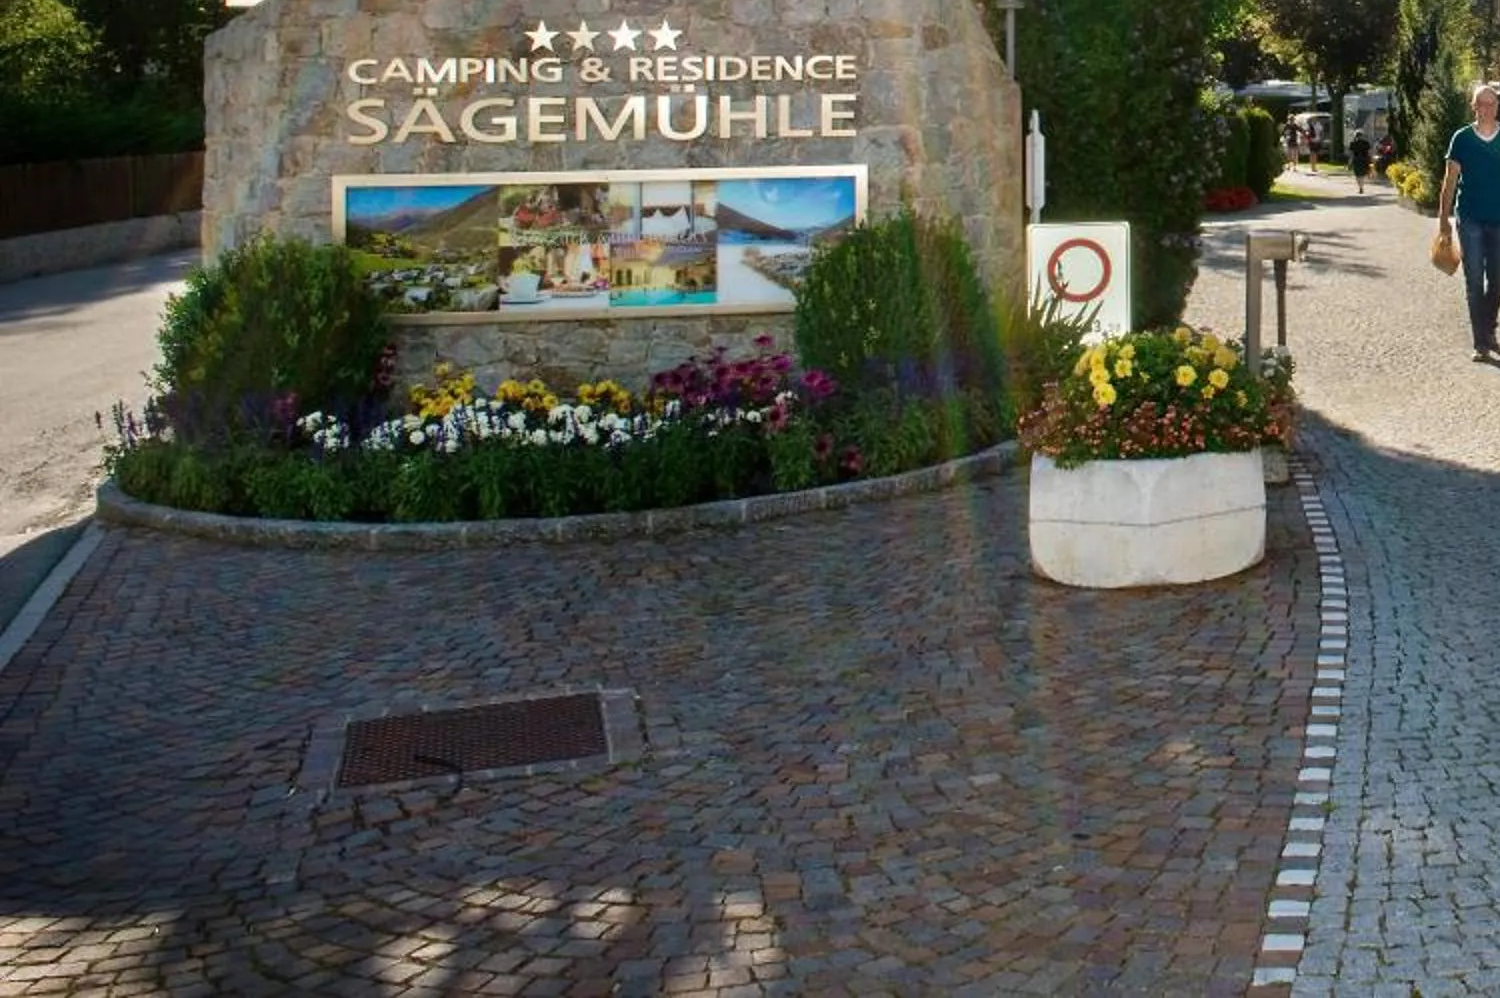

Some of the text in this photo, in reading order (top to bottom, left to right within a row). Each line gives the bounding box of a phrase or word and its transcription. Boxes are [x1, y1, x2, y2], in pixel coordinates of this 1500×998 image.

[349, 54, 857, 84] CAMPING & RESIDENCE
[348, 85, 858, 144] SÄGEMÜHLE
